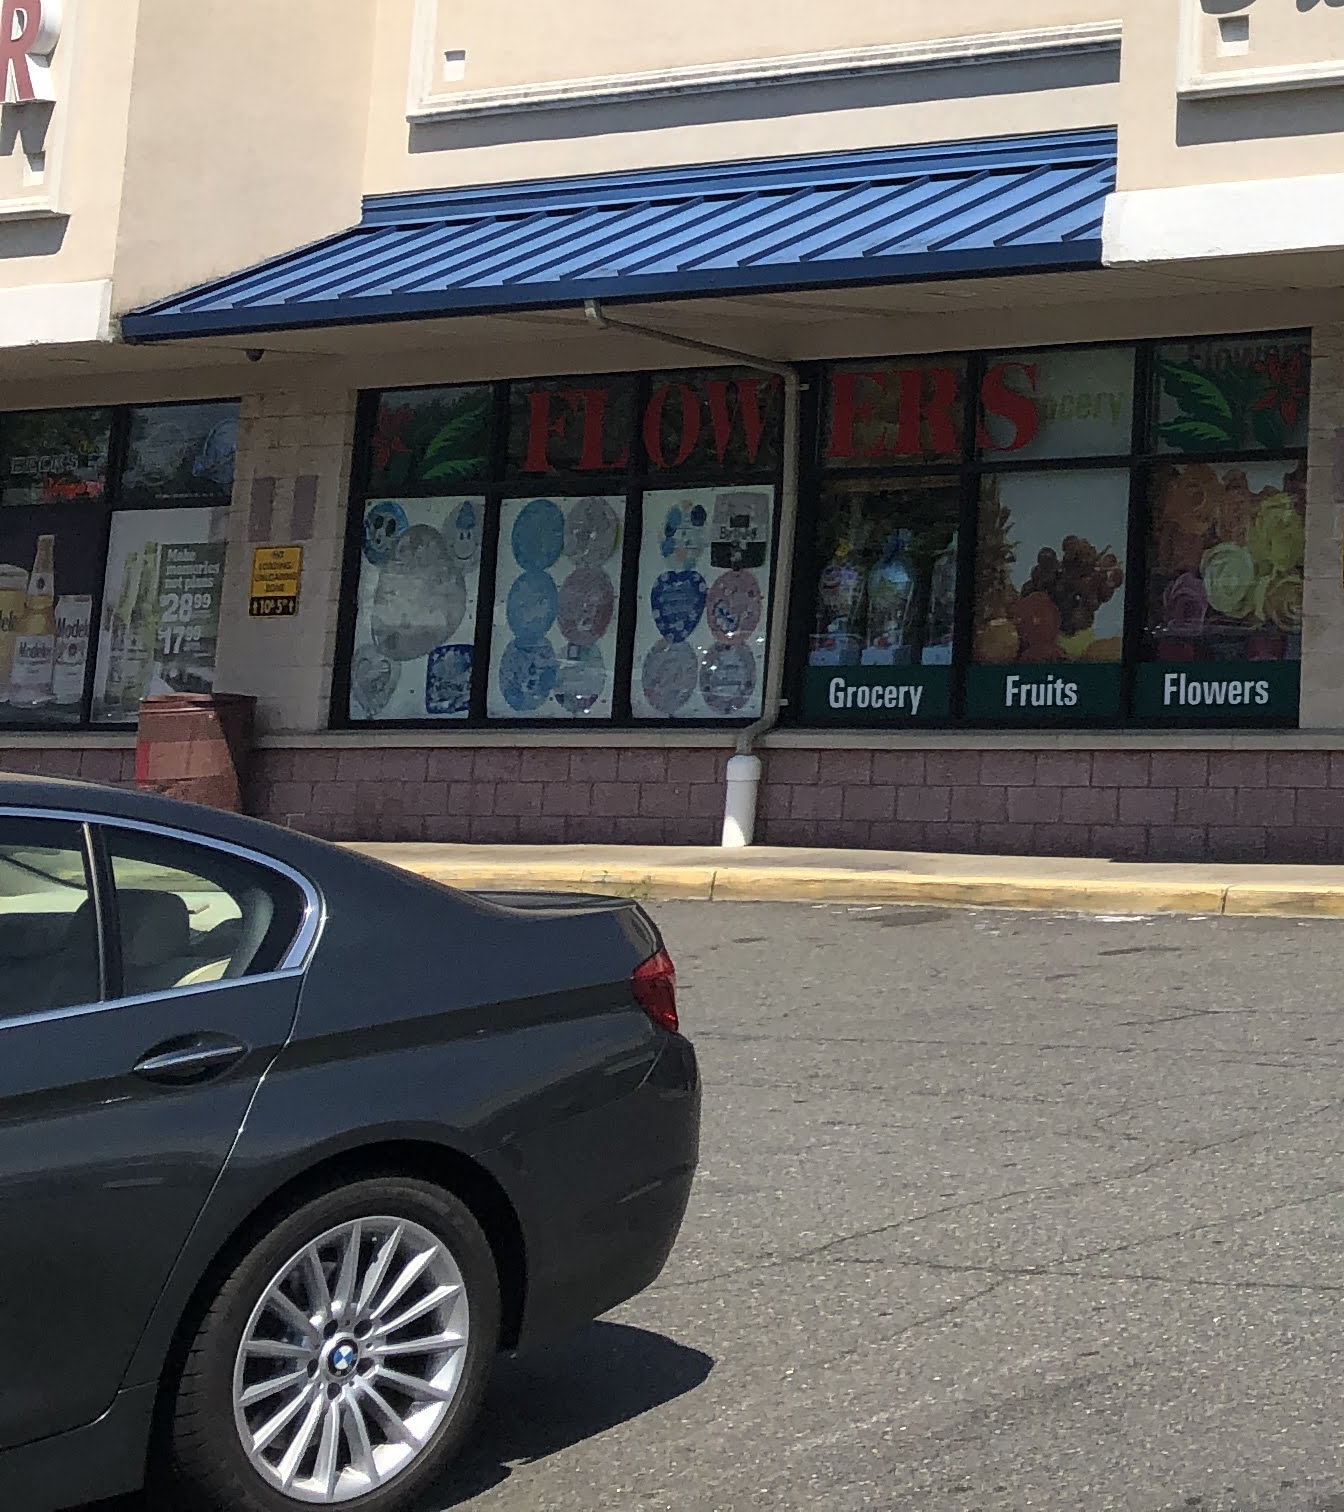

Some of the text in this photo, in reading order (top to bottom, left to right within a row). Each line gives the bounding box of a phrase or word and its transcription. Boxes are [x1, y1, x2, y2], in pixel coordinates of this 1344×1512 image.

[829, 678, 923, 715] Grocery
[1005, 675, 1078, 707] Fruits
[1163, 673, 1269, 706] Flowers
